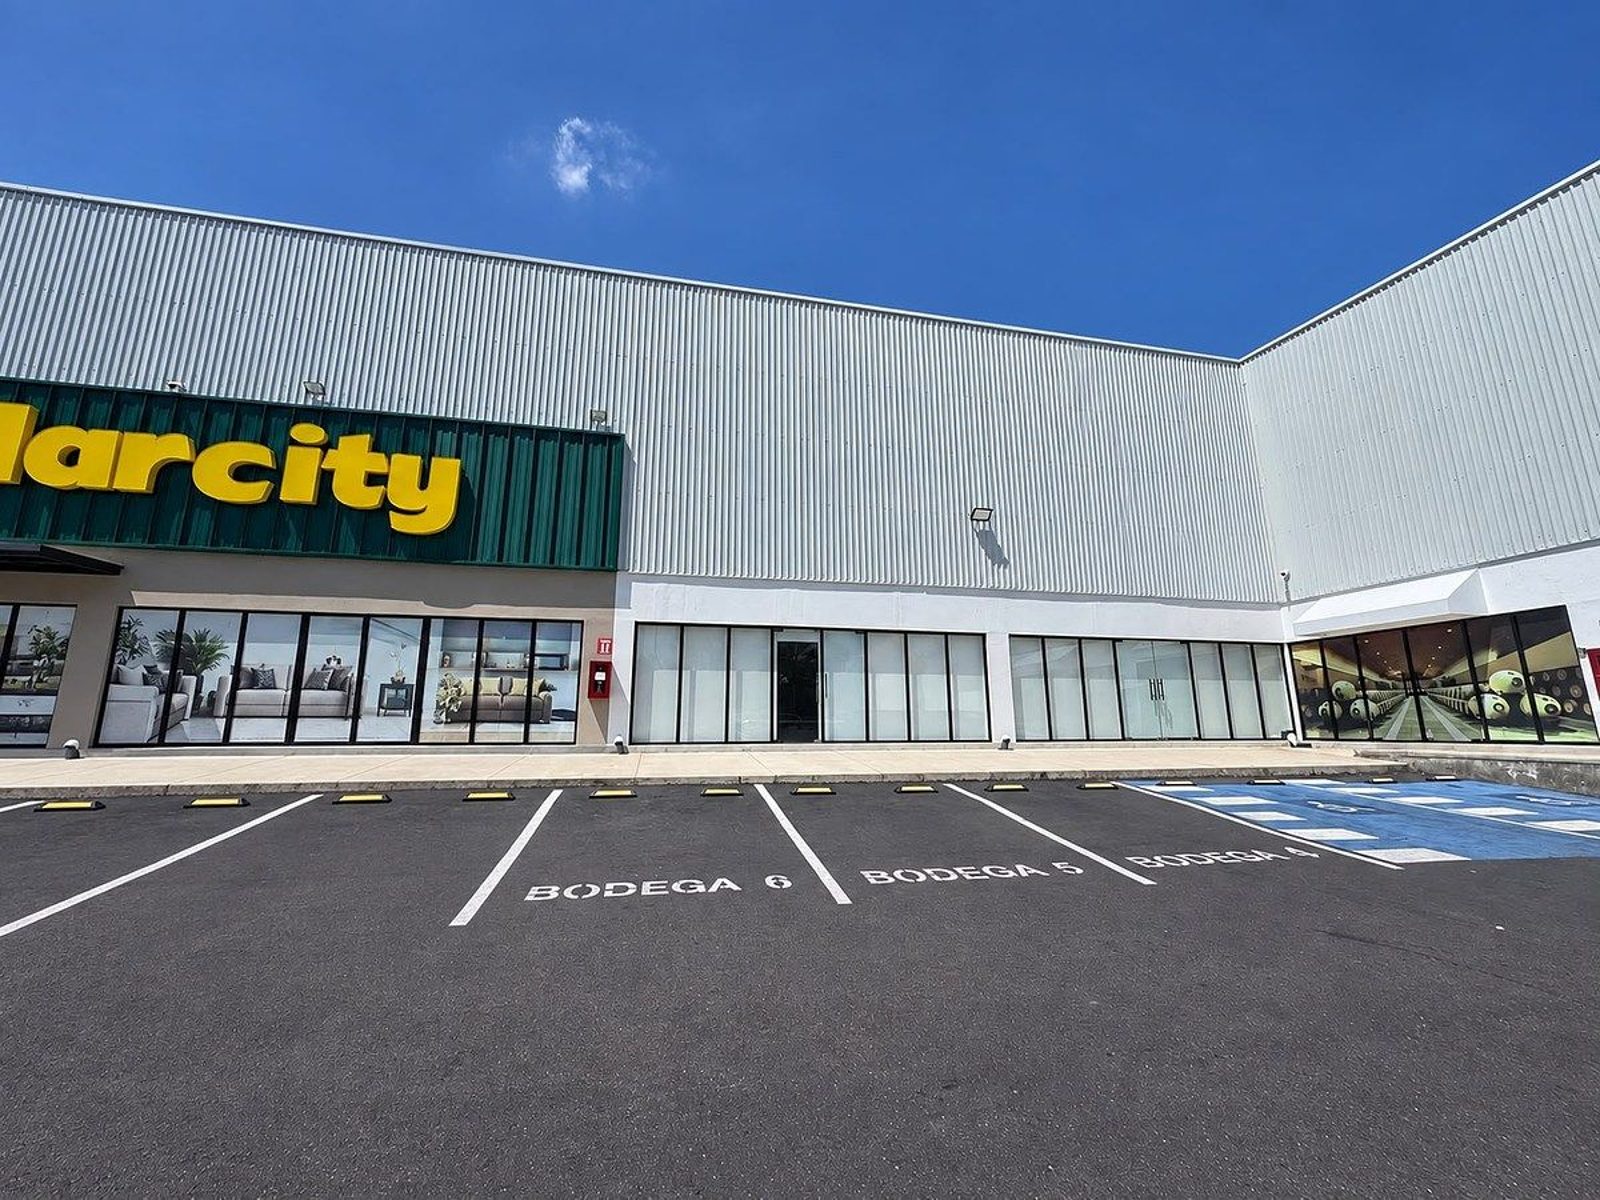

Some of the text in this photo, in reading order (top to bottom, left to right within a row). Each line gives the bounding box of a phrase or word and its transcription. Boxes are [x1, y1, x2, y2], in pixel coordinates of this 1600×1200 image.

[1125, 846, 1320, 868] BODEGA 4
[859, 861, 1084, 884] BODEGA 5
[524, 874, 793, 901] BODEGA 6
